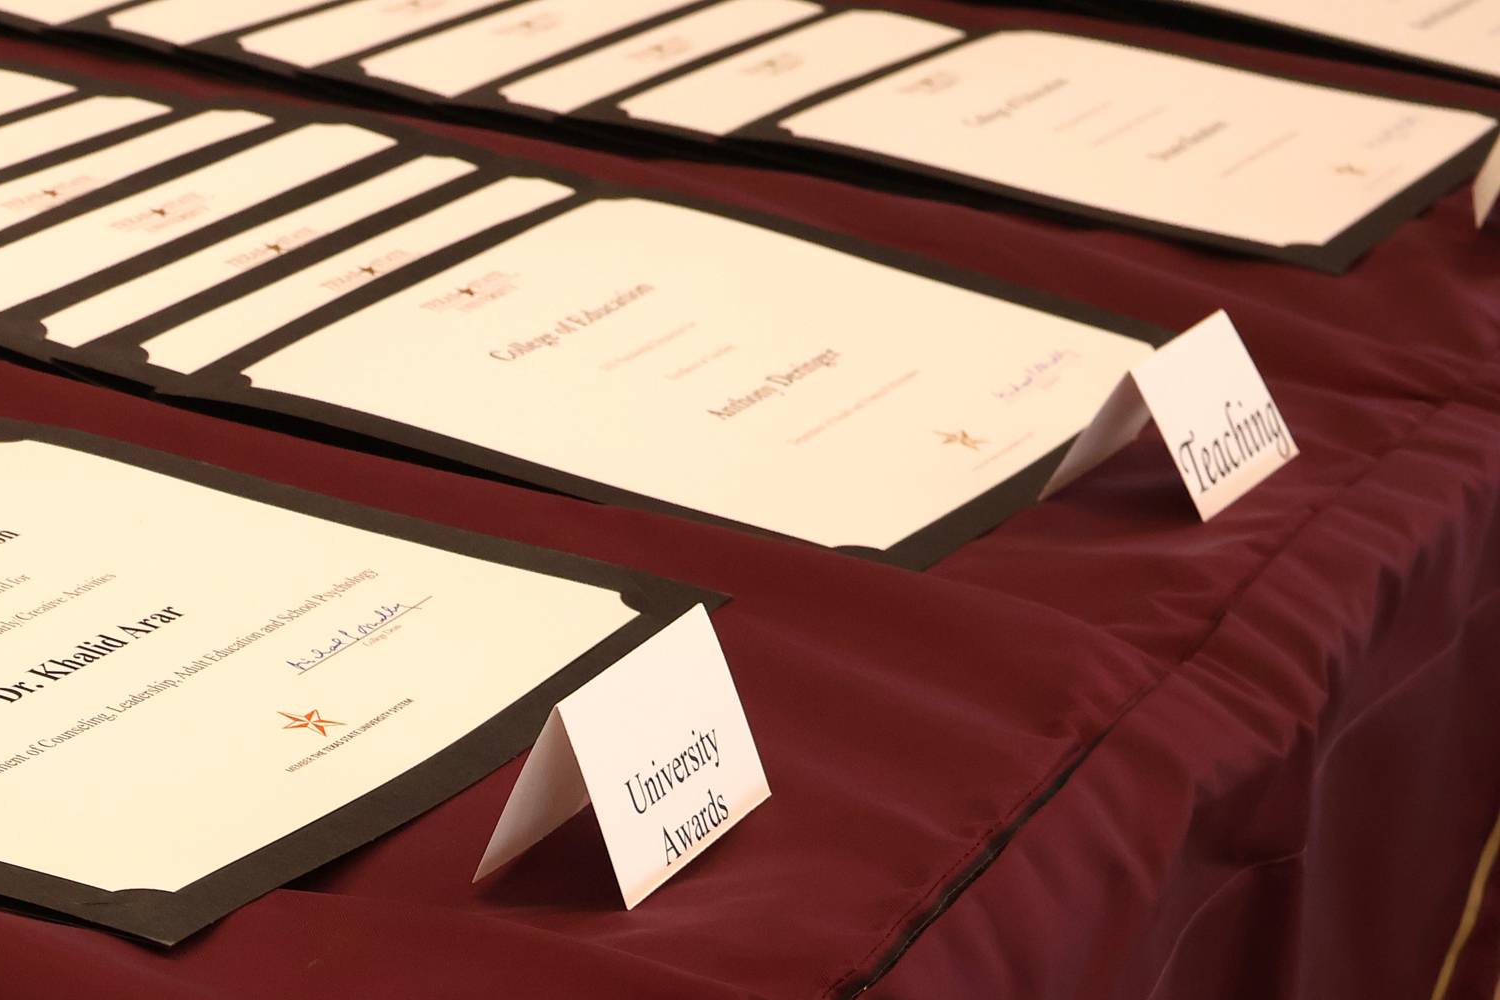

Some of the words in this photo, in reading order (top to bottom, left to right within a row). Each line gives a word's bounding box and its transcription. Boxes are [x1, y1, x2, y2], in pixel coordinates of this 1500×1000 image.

[1177, 400, 1292, 494] Teaching
[7, 572, 32, 588] for
[61, 571, 118, 601] Activities
[24, 634, 131, 683] Khalid
[116, 604, 186, 641] Arar
[24, 743, 46, 758] of
[36, 710, 119, 751] Counseling,
[104, 673, 184, 716] Leadership,
[173, 657, 213, 682] Adult
[202, 627, 266, 664] Education
[259, 618, 286, 635] and
[277, 597, 323, 624] School
[311, 567, 380, 603] Psychology
[623, 728, 721, 815] University
[661, 788, 730, 867] Awards
